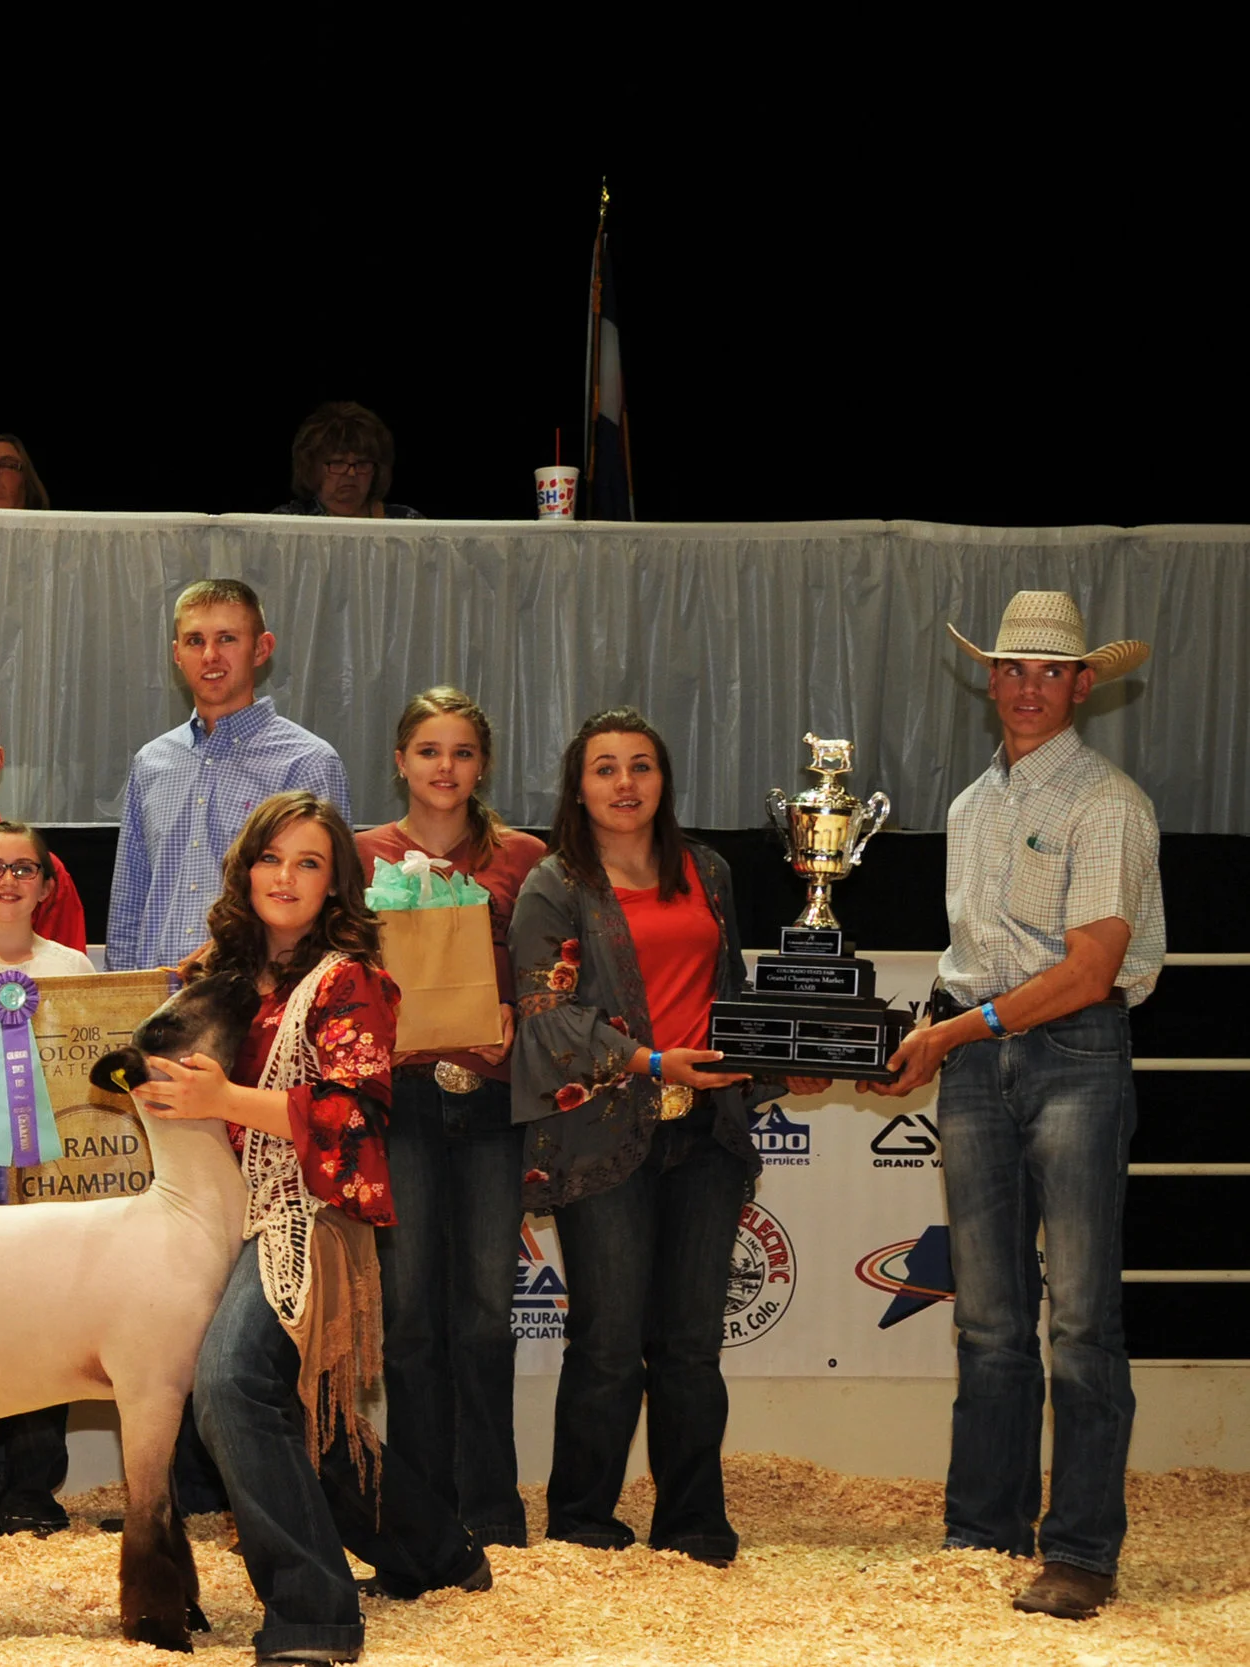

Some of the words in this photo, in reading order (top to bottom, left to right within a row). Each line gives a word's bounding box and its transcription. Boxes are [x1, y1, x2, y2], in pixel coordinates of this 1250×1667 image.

[70, 1027, 101, 1043] 2018
[873, 1159, 924, 1168] GRAND
[746, 1301, 780, 1330] Colo.
